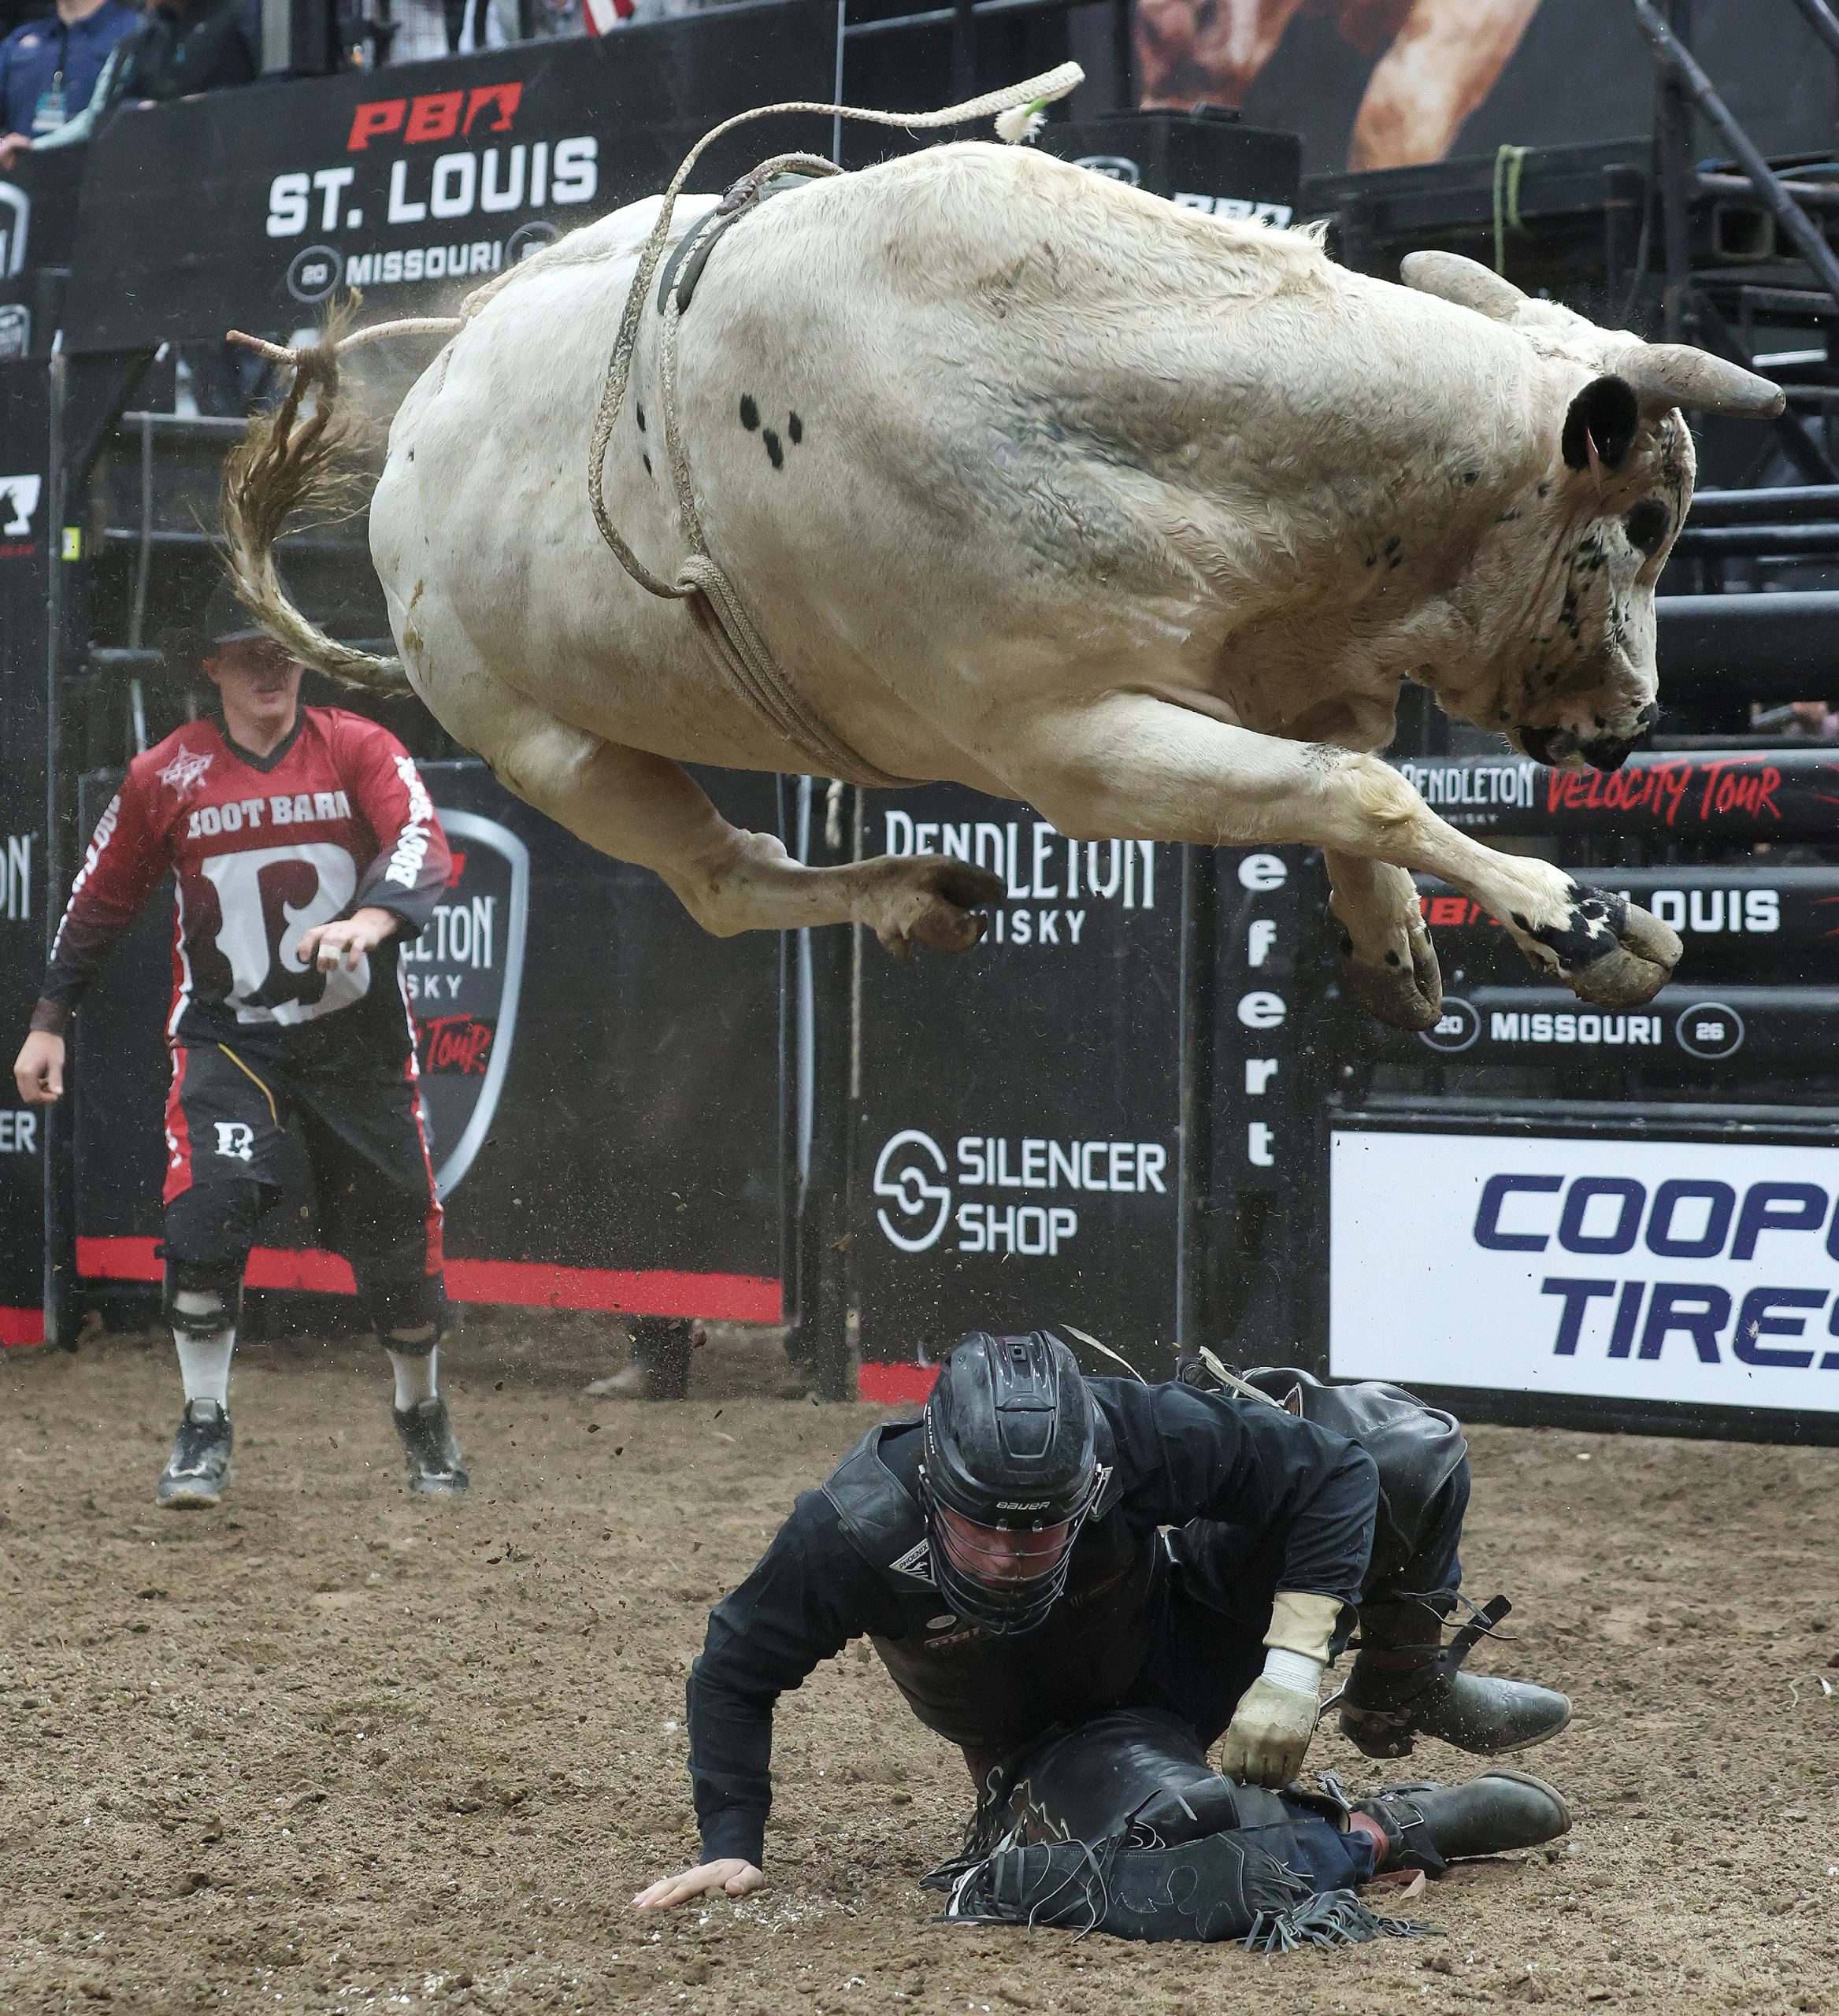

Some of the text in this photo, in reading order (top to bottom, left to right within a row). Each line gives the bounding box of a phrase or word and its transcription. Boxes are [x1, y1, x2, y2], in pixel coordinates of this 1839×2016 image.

[266, 135, 599, 237] ST. LOUIS
[345, 240, 503, 287] MISSOURI
[970, 909, 1086, 945] ISKY
[1619, 889, 1780, 932] OUIS
[1490, 1013, 1663, 1044] MISSOURI
[1696, 1022, 1725, 1041] 26
[957, 1136, 1167, 1193] SILENCER
[958, 1203, 1079, 1256] SHOP
[1474, 1173, 1839, 1260] COOP
[1540, 1276, 1839, 1369] TIRE
[899, 1544, 929, 1569] PHOENIX
